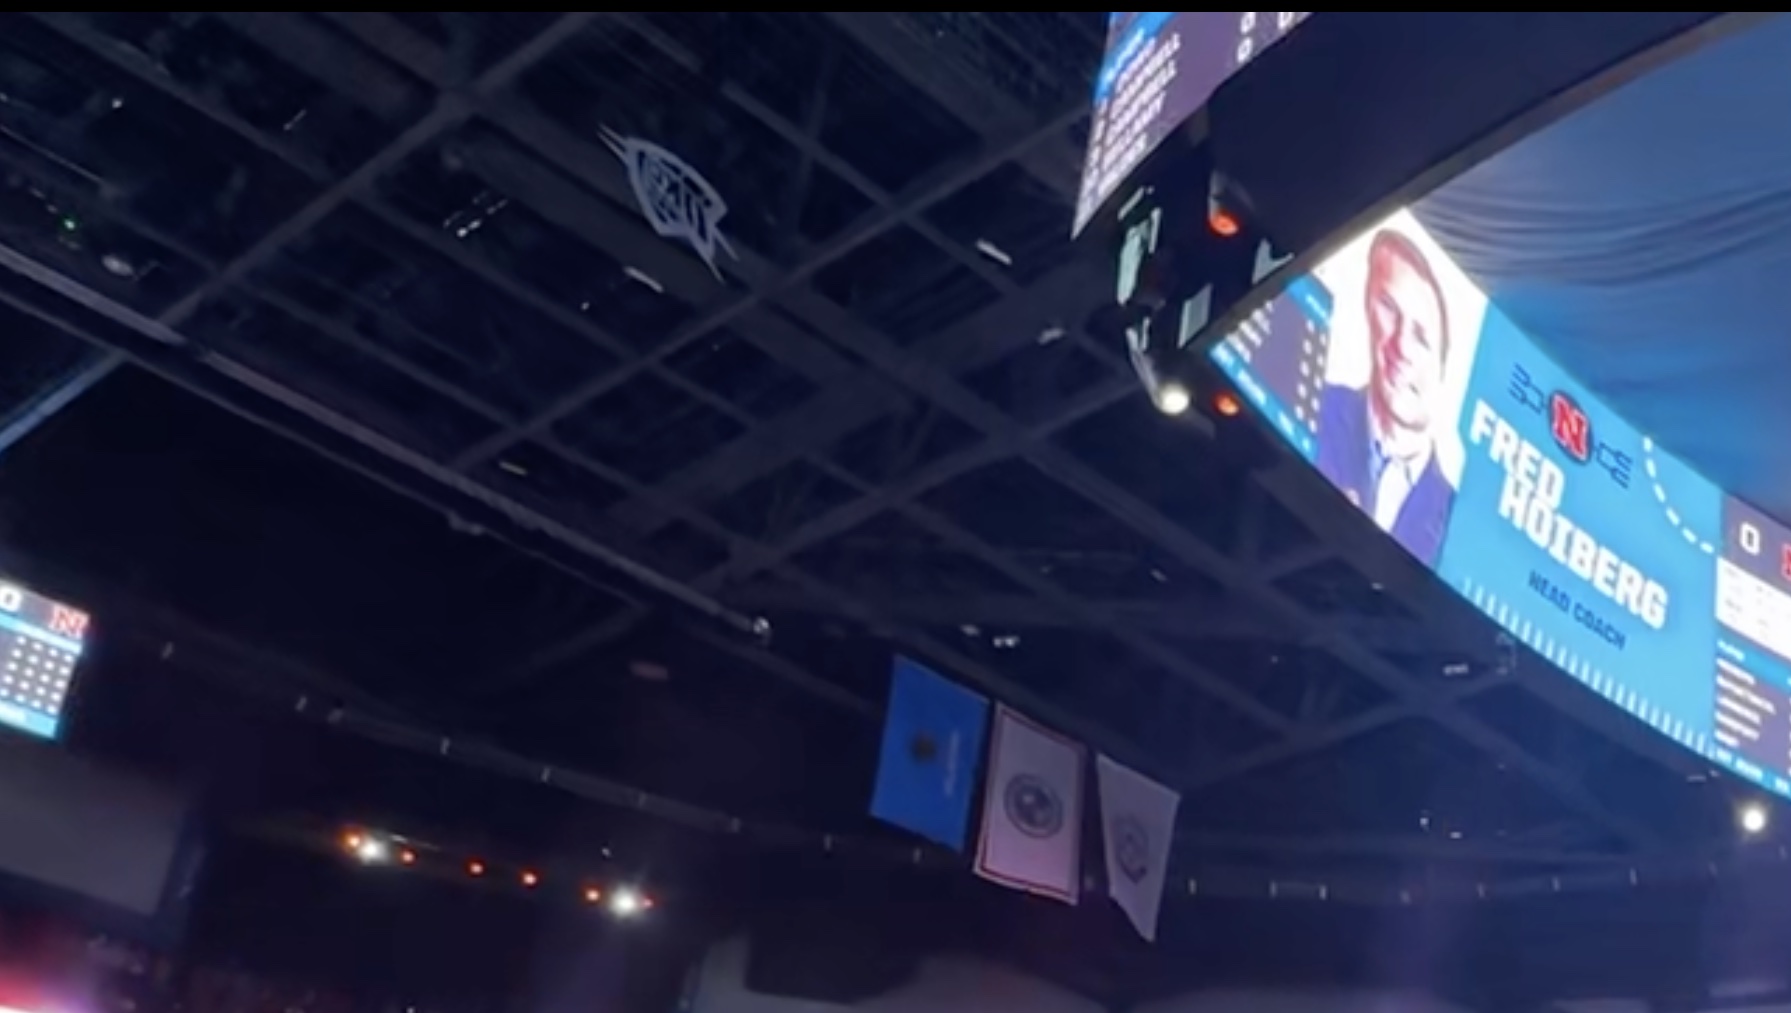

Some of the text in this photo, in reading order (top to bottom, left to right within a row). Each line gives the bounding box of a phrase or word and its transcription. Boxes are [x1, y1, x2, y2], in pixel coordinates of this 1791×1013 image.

[1469, 398, 1565, 511] FRED
[1551, 391, 1589, 462] N
[1499, 472, 1669, 630] HOIBERG
[1740, 522, 1760, 555] 0
[1528, 571, 1627, 651] HEAD COACH
